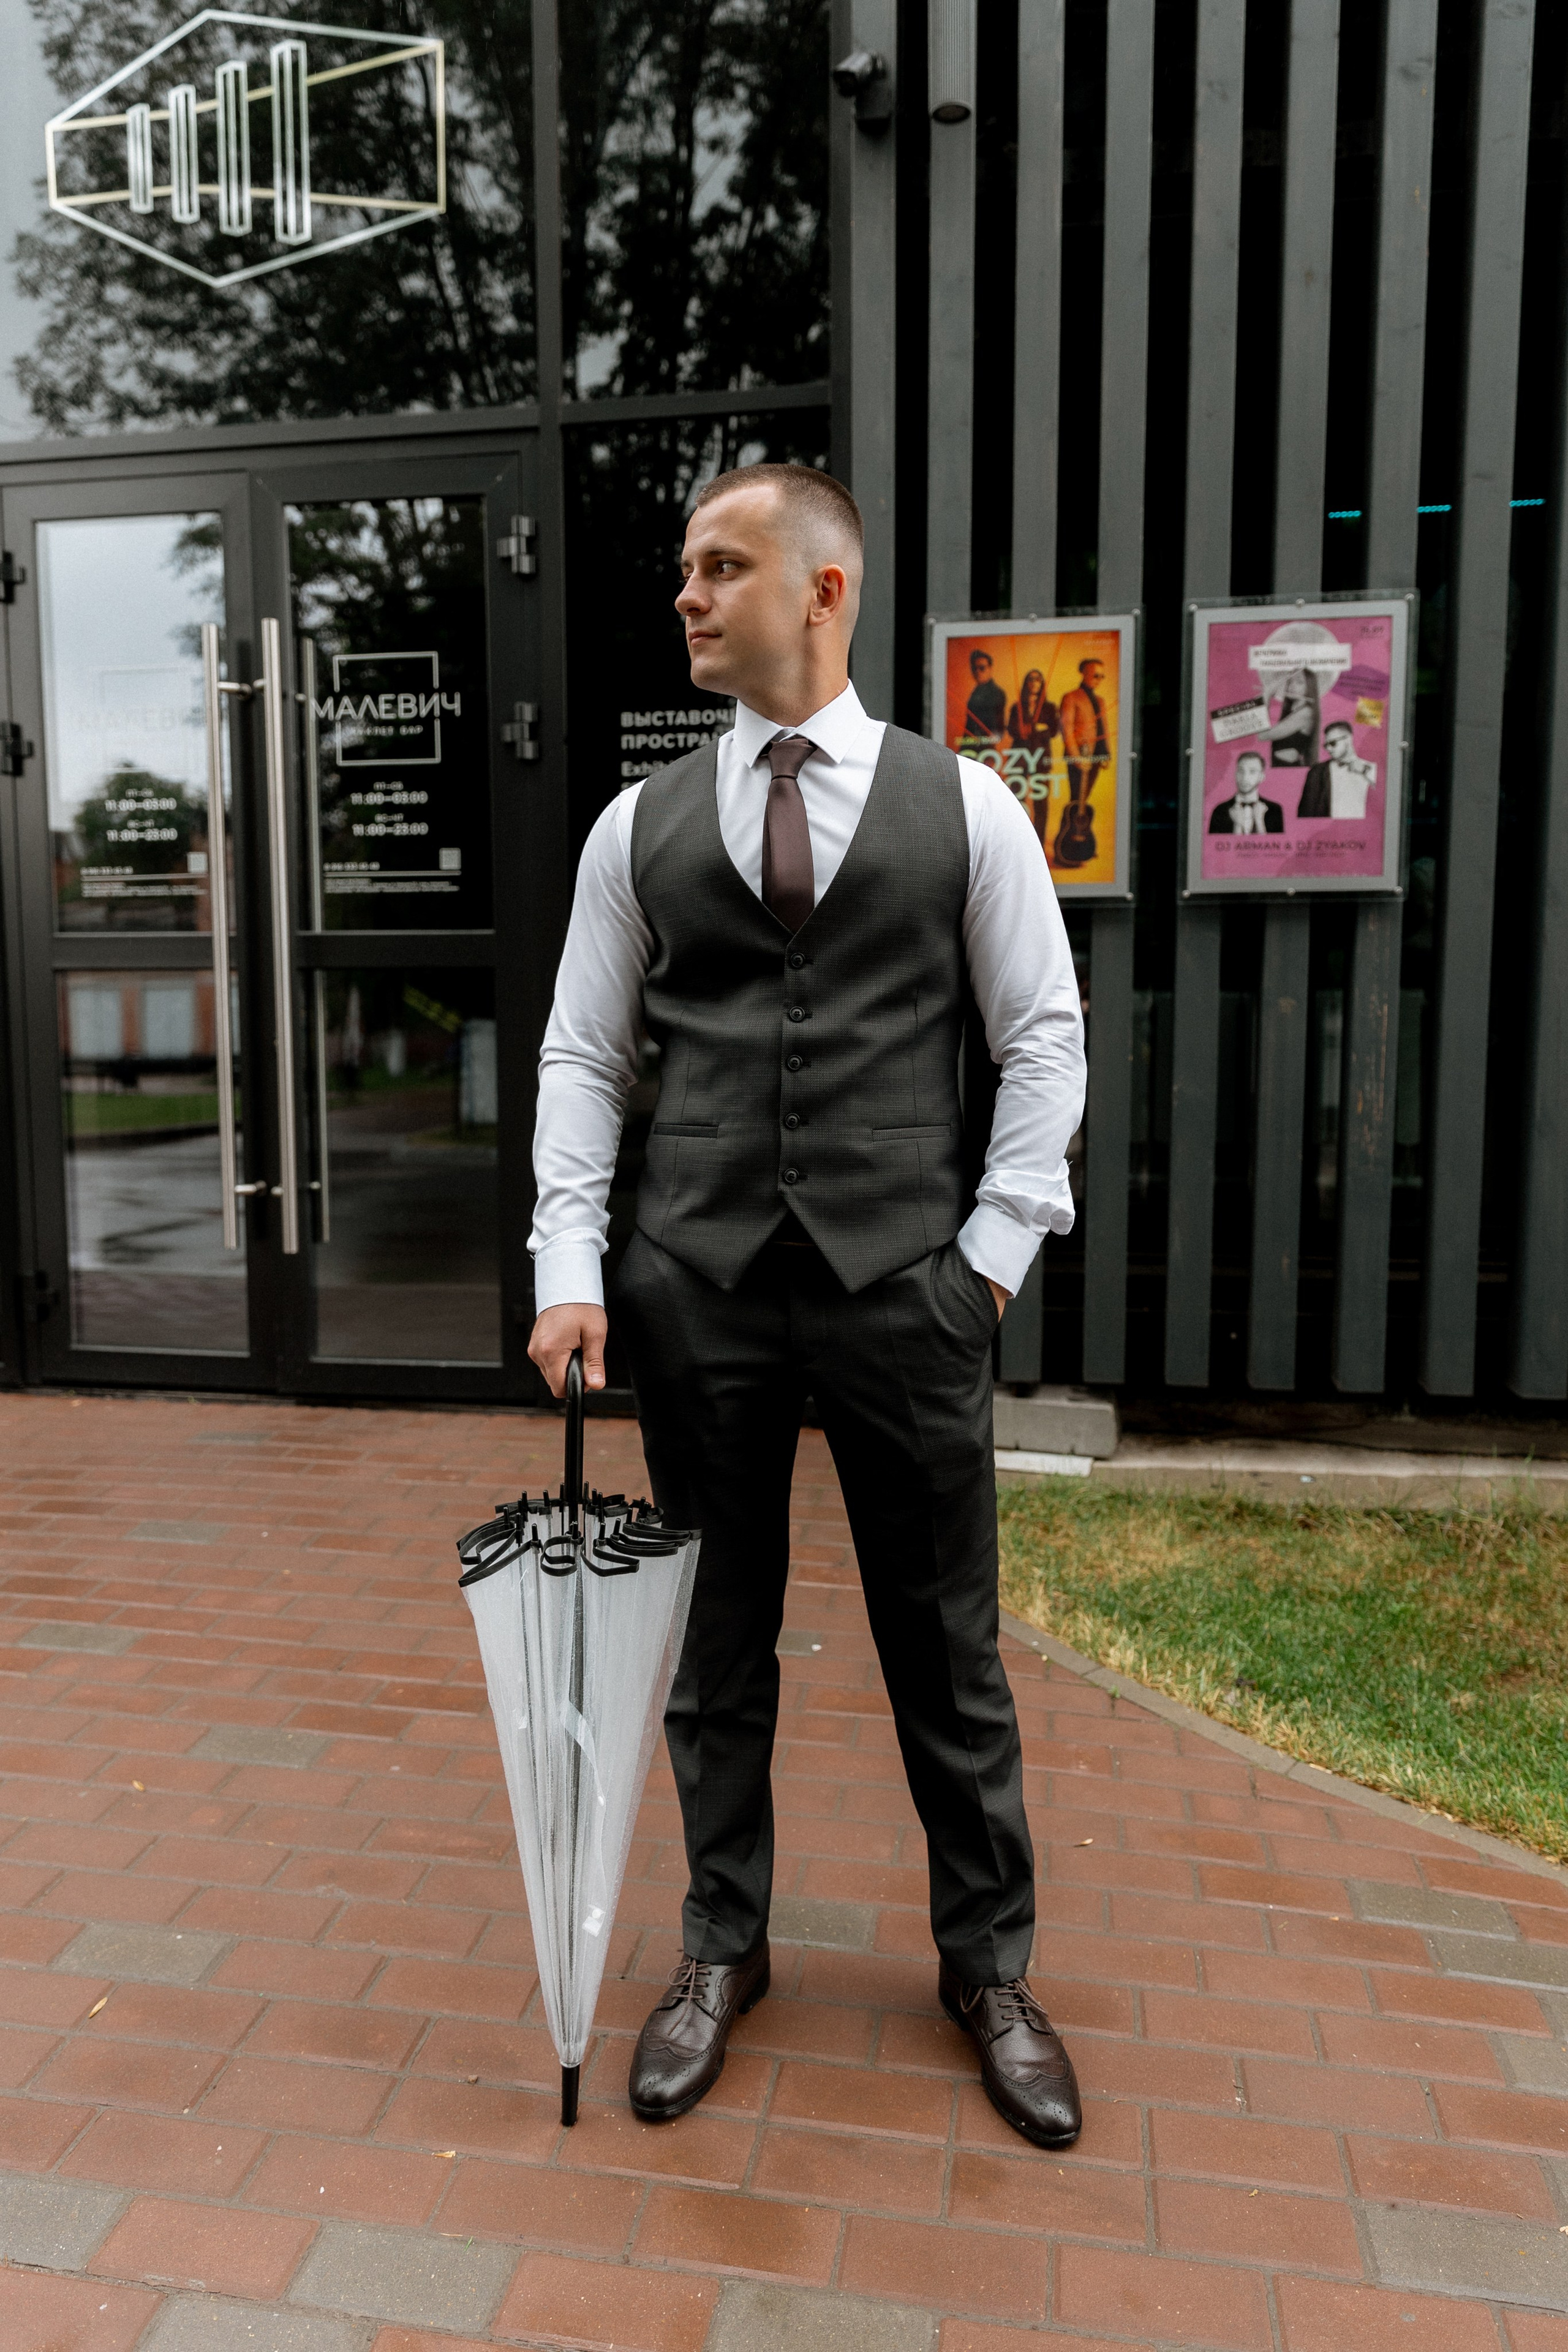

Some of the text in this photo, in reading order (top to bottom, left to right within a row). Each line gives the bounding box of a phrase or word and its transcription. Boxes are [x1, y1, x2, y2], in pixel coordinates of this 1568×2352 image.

[311, 692, 461, 720] МАЛЕВИЧ
[620, 732, 722, 750] ПРОСТРА
[1005, 773, 1068, 801] OST
